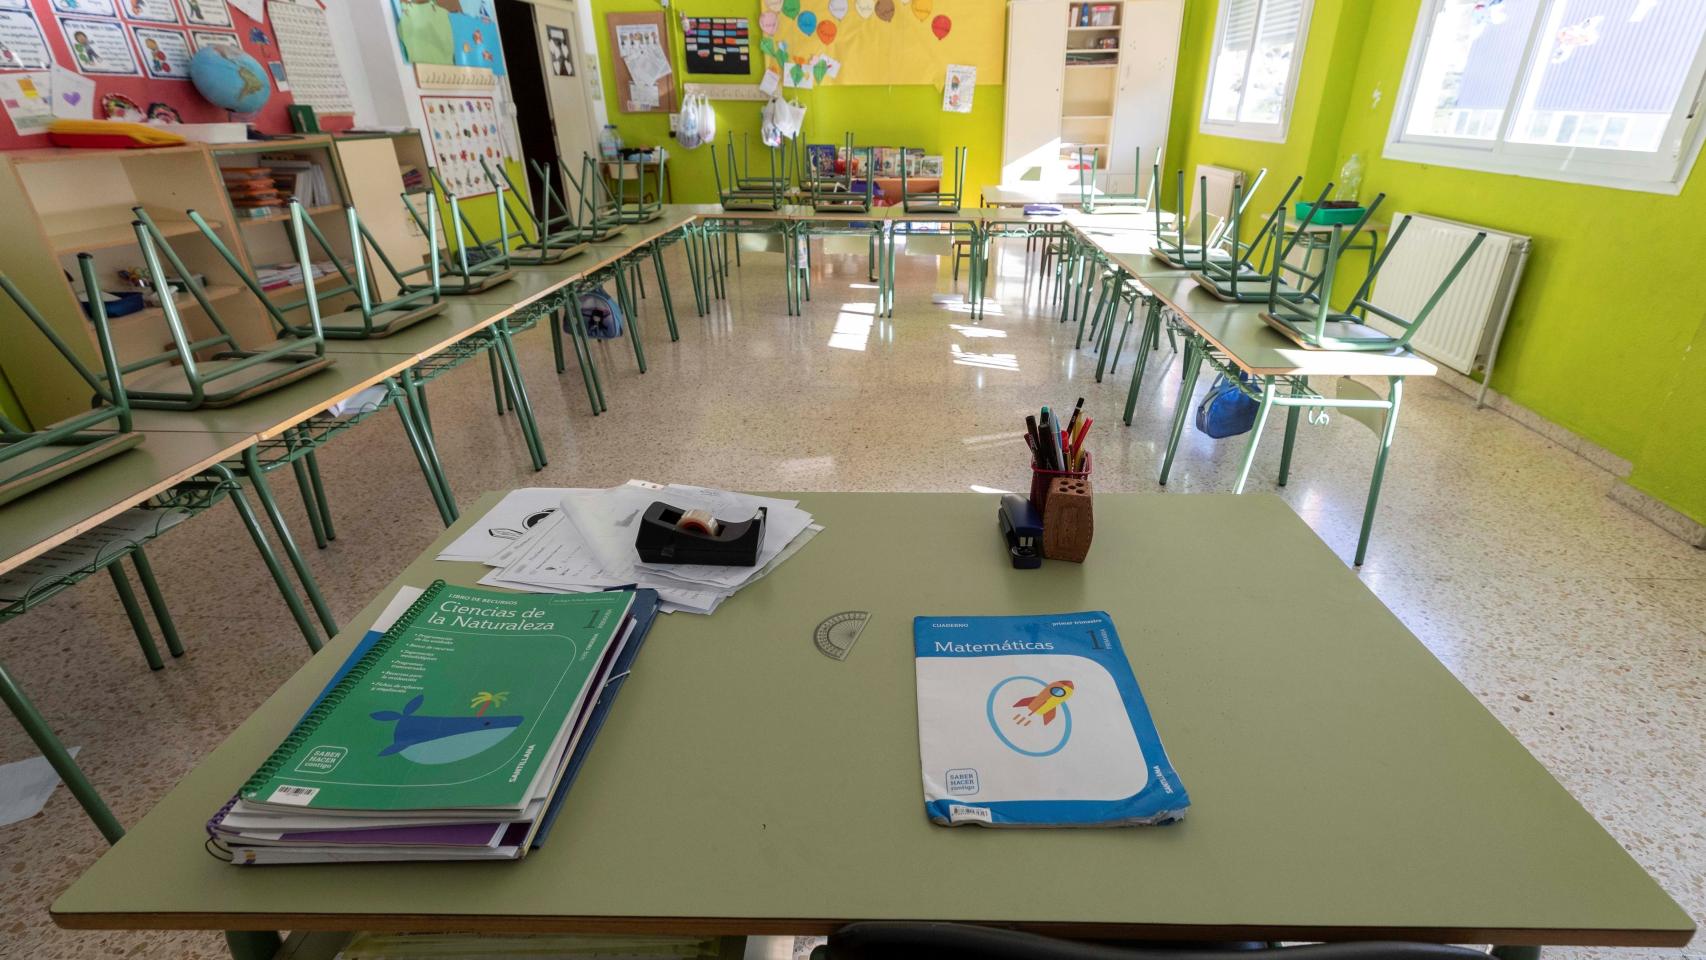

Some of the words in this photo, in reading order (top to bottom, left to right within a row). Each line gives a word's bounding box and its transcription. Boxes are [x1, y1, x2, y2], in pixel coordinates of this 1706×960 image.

[440, 601, 517, 618] Ciencias
[521, 608, 545, 618] de
[482, 598, 518, 606] RECURSOS
[427, 612, 446, 624] la
[450, 616, 555, 630] Naturaleza
[583, 608, 600, 629] 1
[934, 640, 1055, 653] Matemáticas
[1086, 630, 1104, 650] 1
[313, 750, 341, 758] SABER
[508, 744, 536, 783] SANTILLANA
